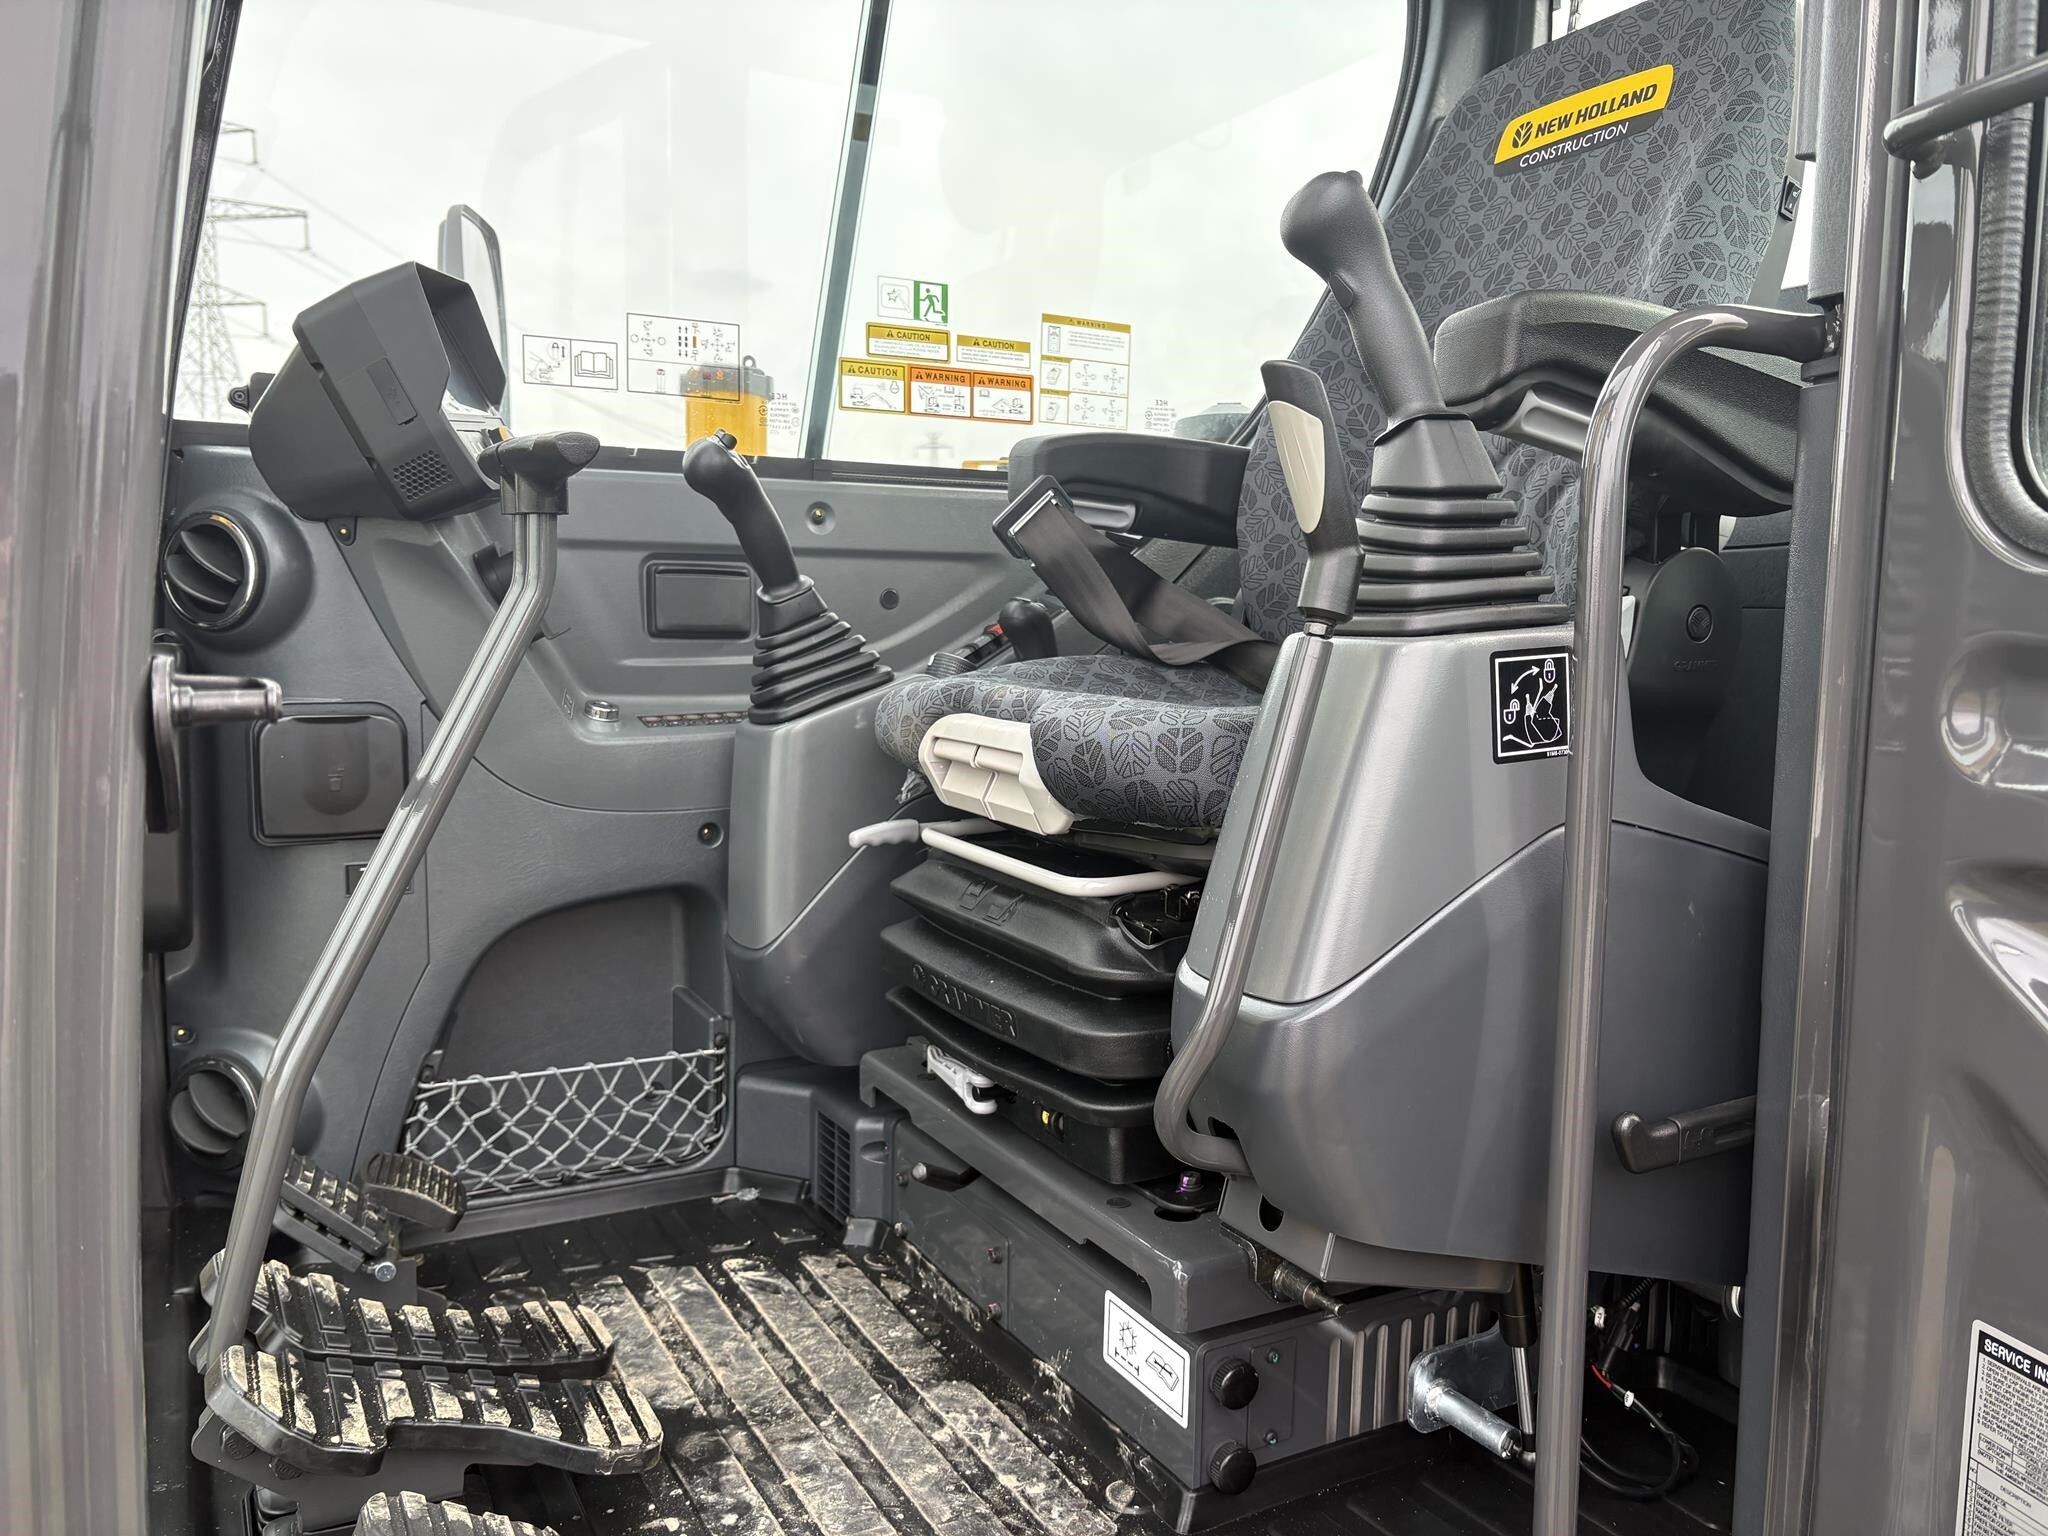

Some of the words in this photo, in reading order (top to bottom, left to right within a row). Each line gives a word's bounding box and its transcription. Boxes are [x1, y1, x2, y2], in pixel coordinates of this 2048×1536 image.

[1535, 112, 1574, 138] NEW
[1575, 83, 1658, 125] HOLLAND
[1519, 122, 1629, 168] CONSTRUCTION
[896, 331, 931, 341] CAUTION
[982, 340, 1015, 350] CAUTION
[857, 365, 898, 377] CAUTION
[924, 371, 966, 383] WARNING
[987, 377, 1026, 388] WARNING
[1984, 1338, 2032, 1374] SERVICE
